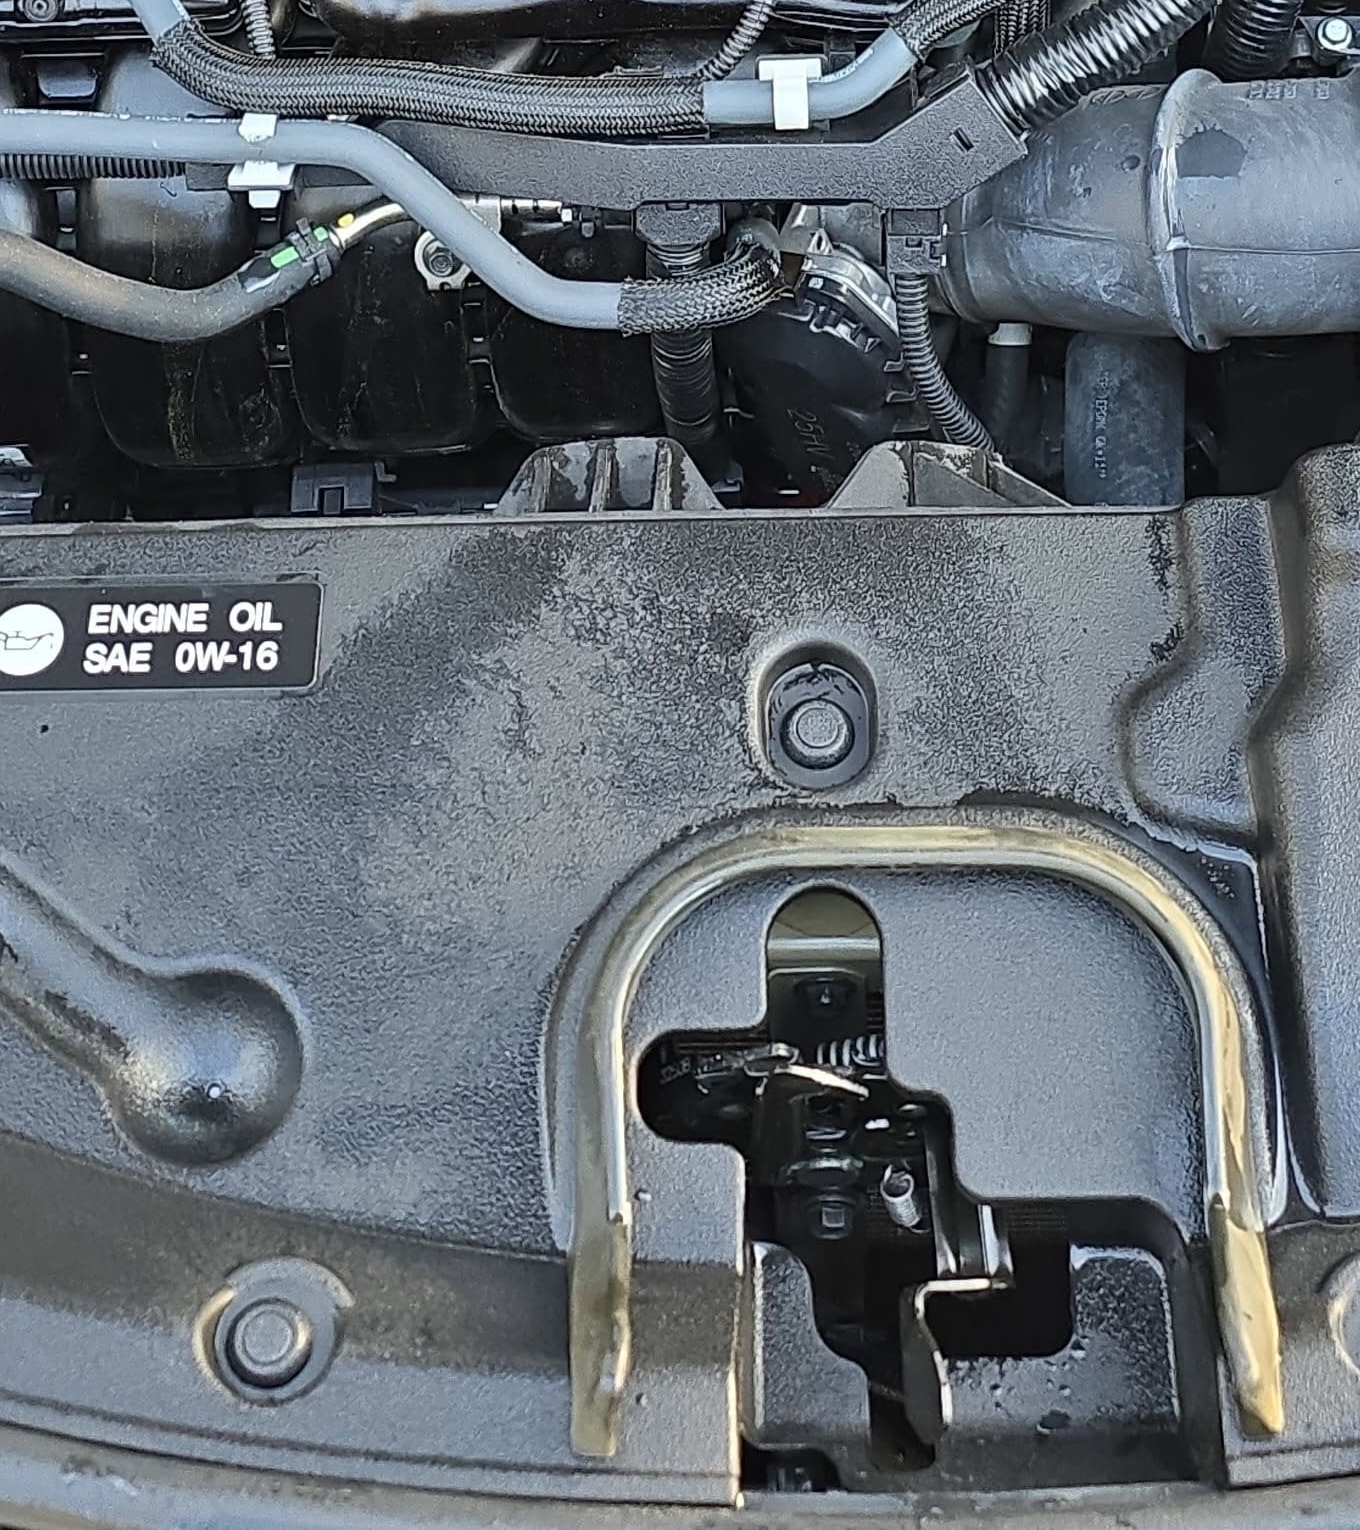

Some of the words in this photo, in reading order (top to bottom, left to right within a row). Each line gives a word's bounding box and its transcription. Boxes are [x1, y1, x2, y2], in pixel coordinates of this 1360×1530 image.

[87, 602, 210, 635] ENGINE
[228, 601, 283, 633] OIL
[82, 642, 153, 674] SAE
[175, 640, 280, 672] 0W-16
